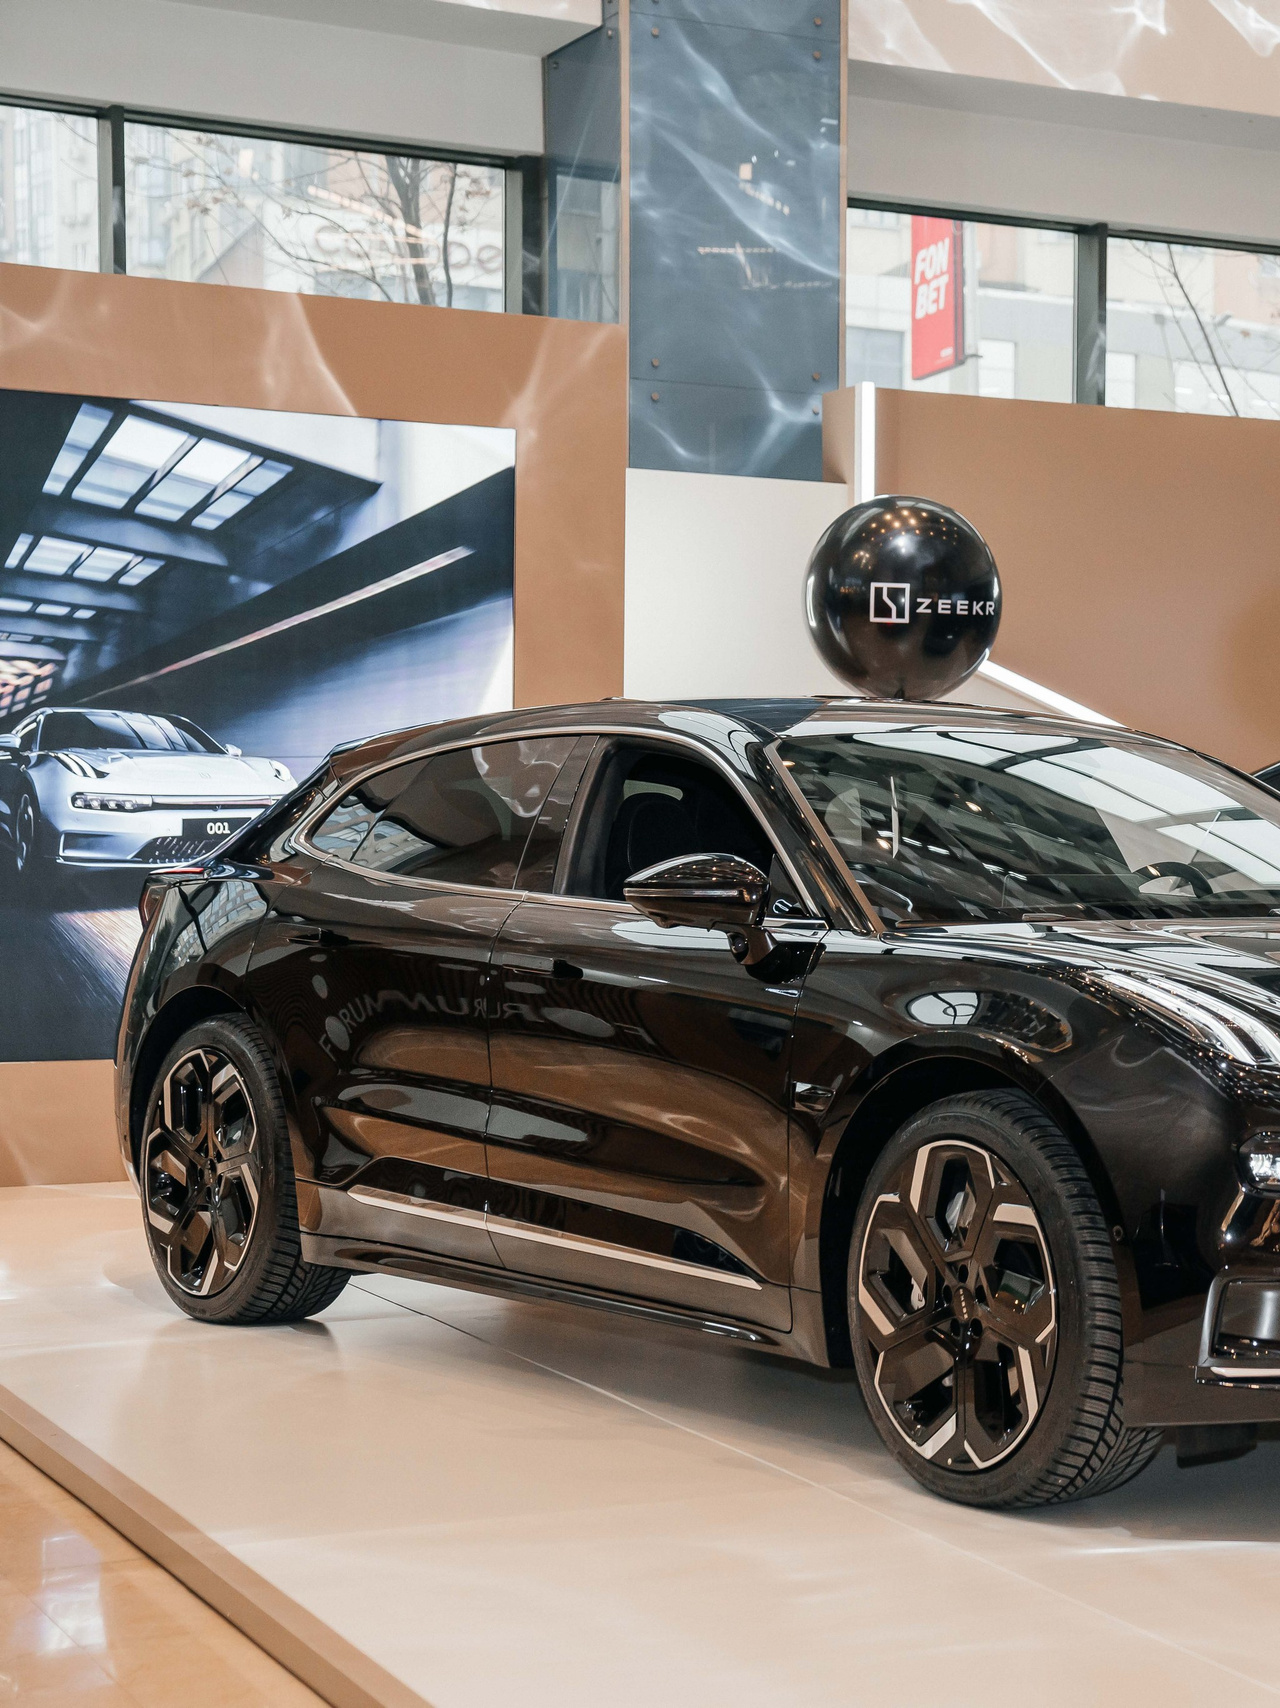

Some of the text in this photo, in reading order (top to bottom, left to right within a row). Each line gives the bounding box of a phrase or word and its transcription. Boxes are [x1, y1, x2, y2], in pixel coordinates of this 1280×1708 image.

[914, 237, 950, 286] FON
[915, 274, 950, 320] BET
[915, 597, 995, 616] ZEEKR
[206, 822, 231, 835] 001
